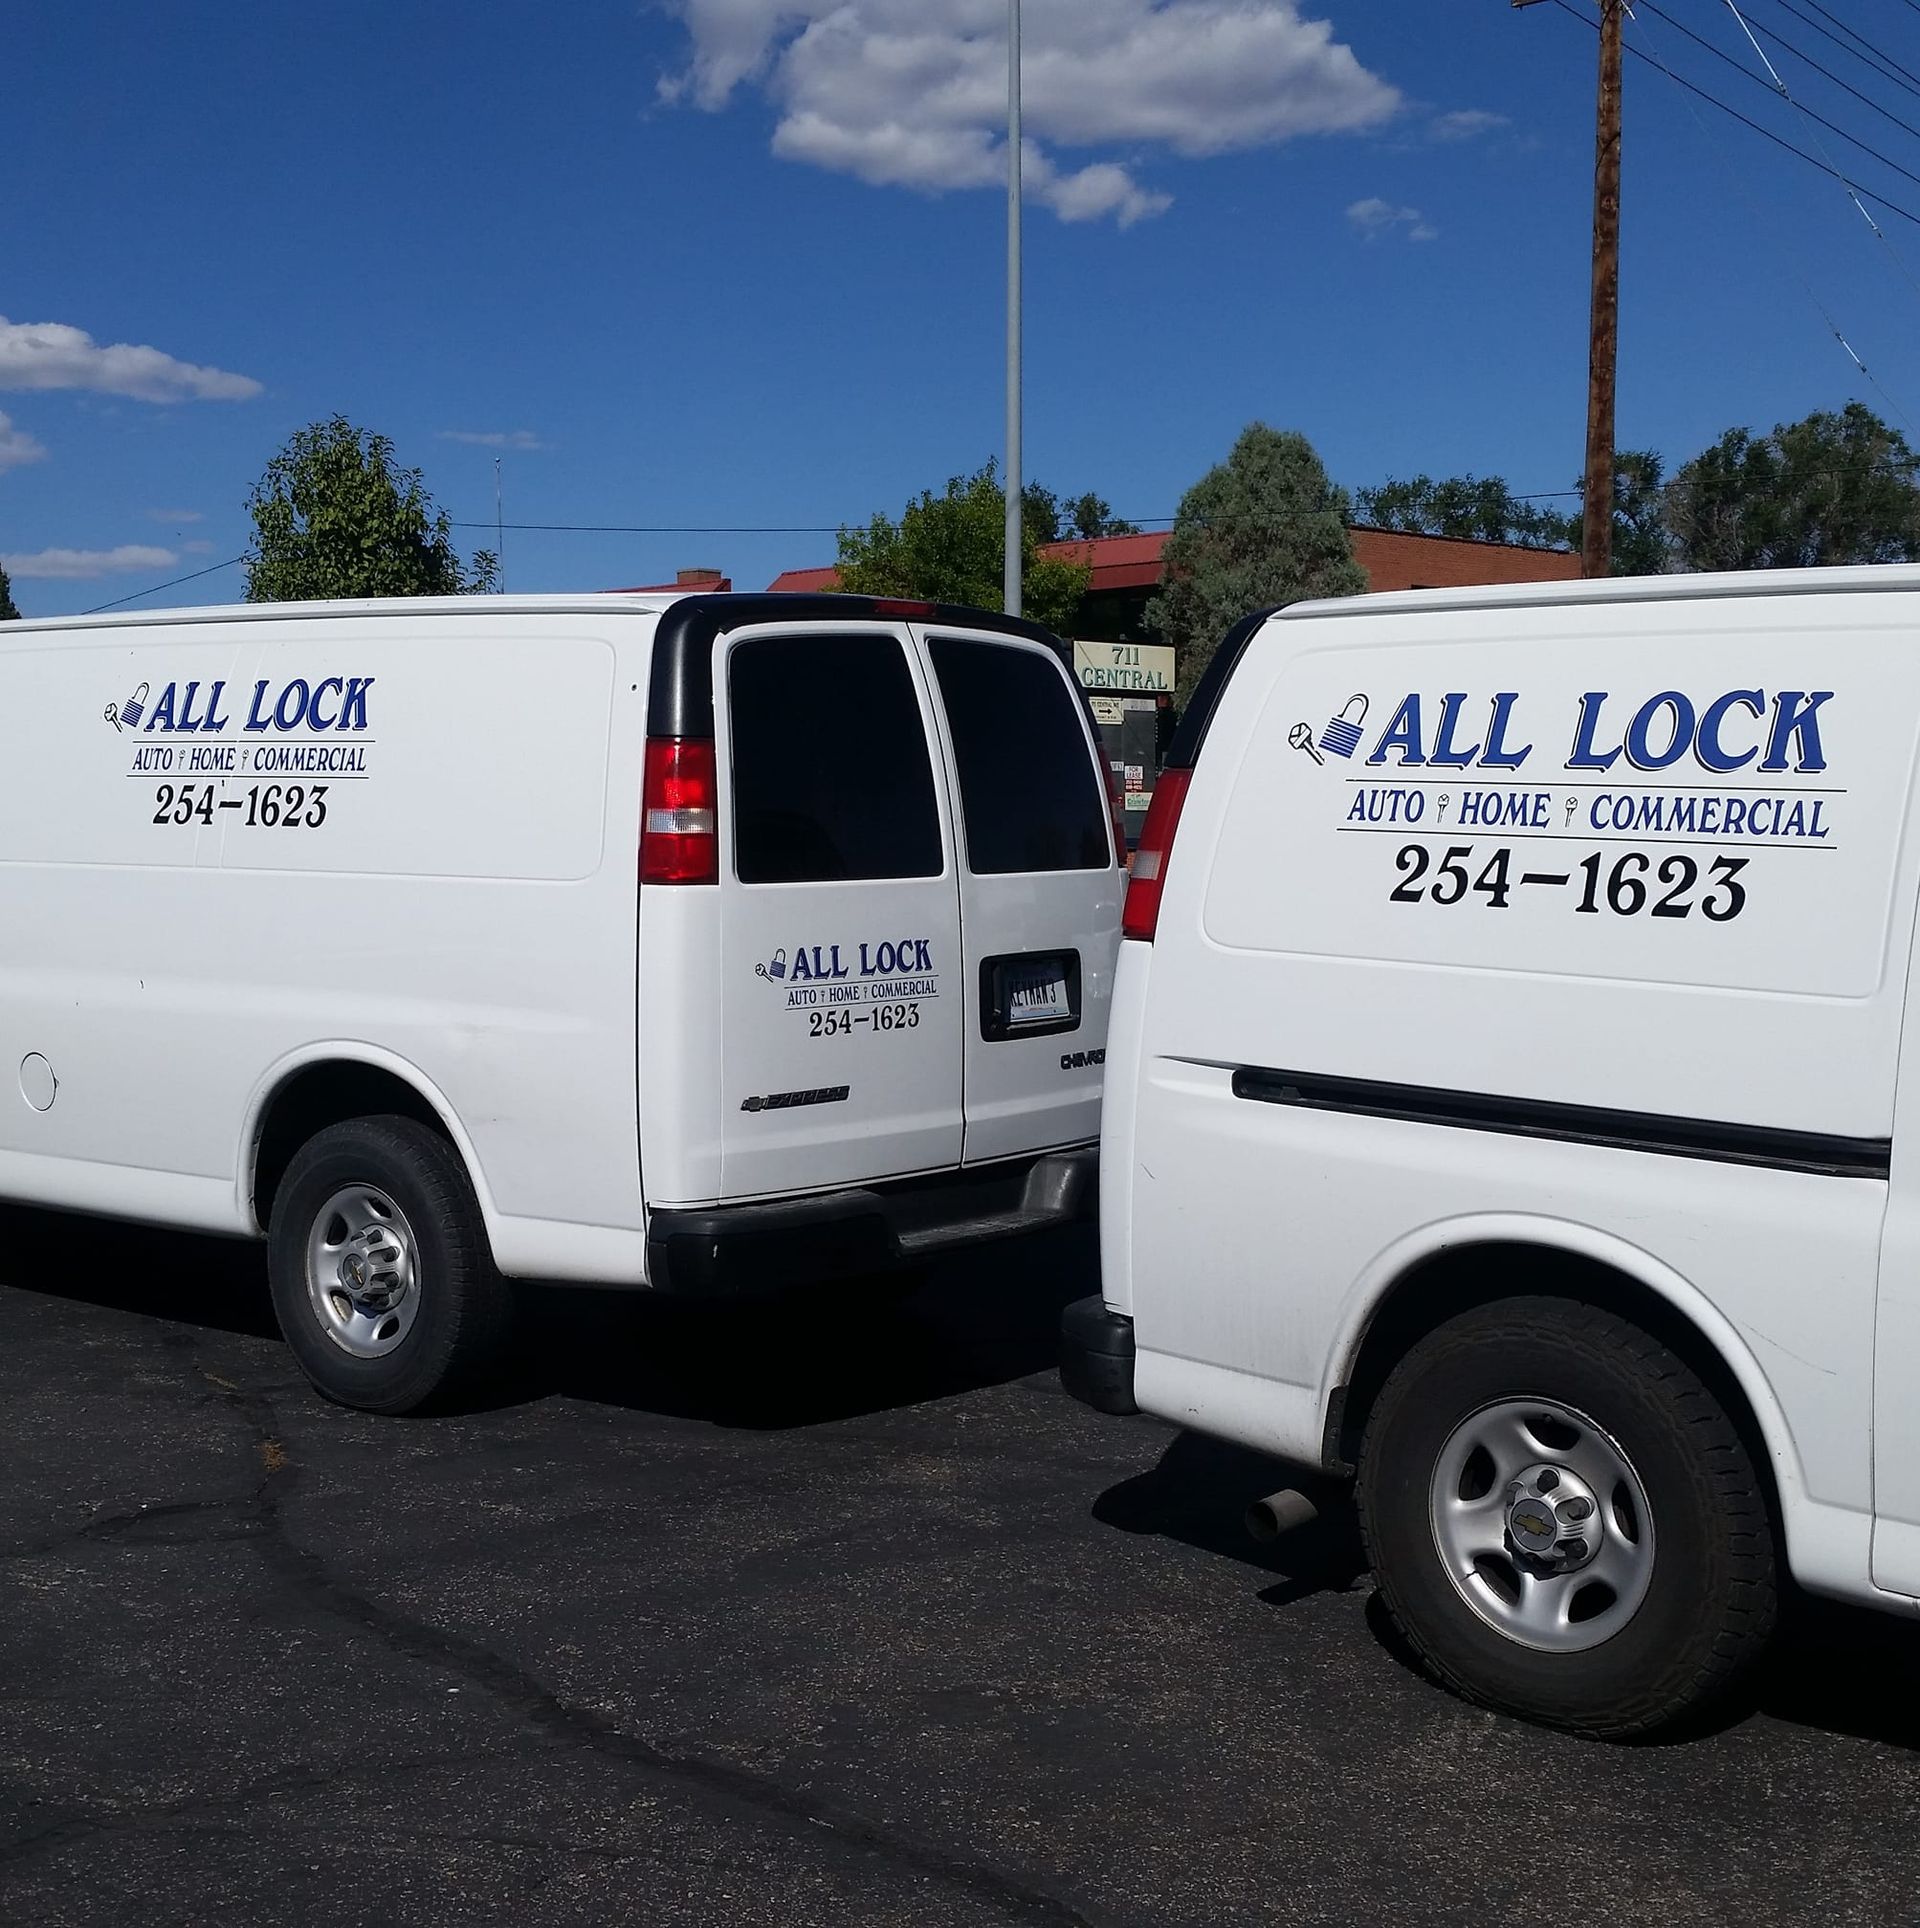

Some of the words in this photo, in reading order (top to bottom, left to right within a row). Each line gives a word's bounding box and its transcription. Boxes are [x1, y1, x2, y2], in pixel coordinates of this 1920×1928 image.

[1112, 646, 1139, 665] 711
[1082, 667, 1168, 690] CENTRAL
[143, 680, 229, 733] ALL
[243, 676, 376, 733] LOCK
[1365, 692, 1532, 771] ALL
[1564, 688, 1835, 774] LOCK
[132, 747, 173, 771] AUTO
[189, 747, 236, 771] HOME
[254, 747, 367, 773] COMMERCIAL
[152, 783, 330, 828] 254-1623
[1346, 789, 1424, 823] AUTO
[1458, 792, 1551, 828] HOME
[1589, 794, 1831, 838] COMMERCIAL
[1389, 844, 1751, 922] 254-1623
[790, 945, 849, 981] ALL
[859, 939, 933, 976] LOCK
[787, 989, 817, 1006] AUTO
[829, 986, 860, 1003] HOME
[871, 979, 937, 999] COMMERCIAL
[809, 1003, 920, 1037] 254-1623
[1061, 1048, 1106, 1070] CHEVRO
